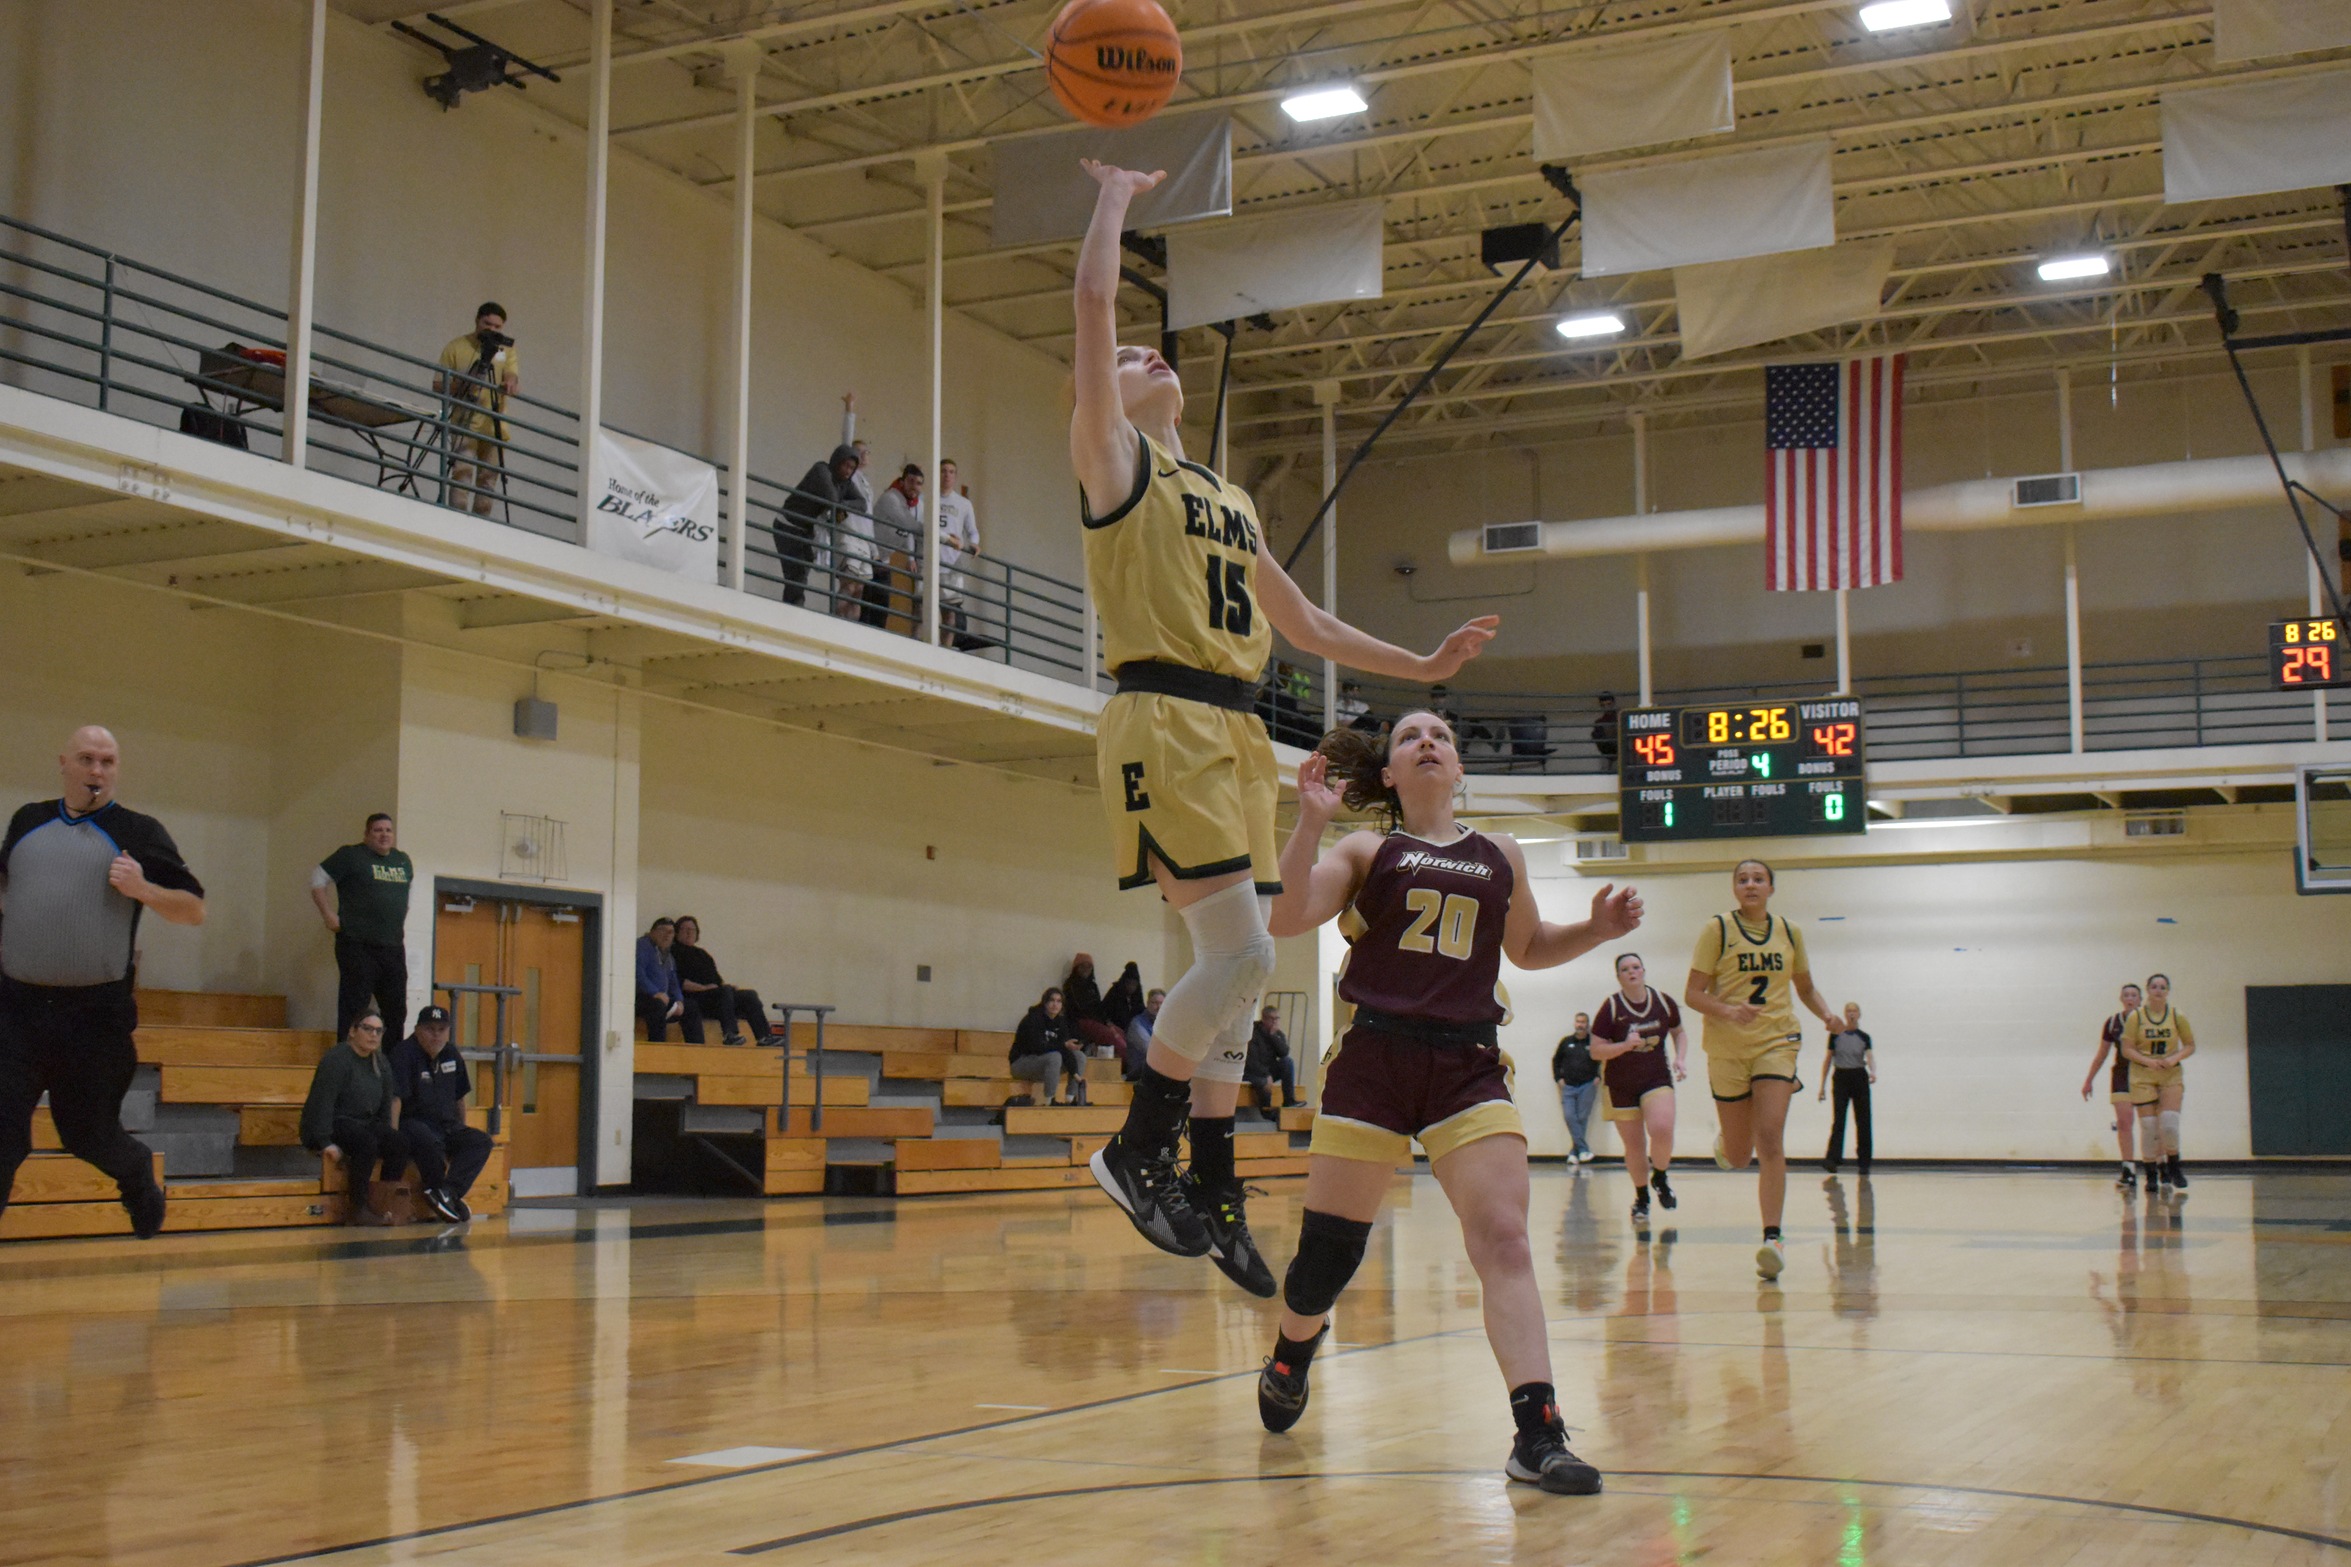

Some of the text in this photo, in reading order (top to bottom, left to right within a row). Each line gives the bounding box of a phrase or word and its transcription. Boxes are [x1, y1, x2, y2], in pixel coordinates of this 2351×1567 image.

[1097, 46, 1176, 73] Wilson
[608, 477, 661, 508] Home of the
[596, 493, 714, 542] BLAERS
[1181, 493, 1257, 556] ELMS
[1205, 553, 1252, 637] 15
[2285, 621, 2337, 643] 8 26
[2281, 645, 2331, 683] 29
[1628, 713, 1671, 729] HOME
[1801, 701, 1860, 719] VISITOR
[1708, 708, 1790, 743] 8:26
[1634, 733, 1675, 765] 45
[1813, 723, 1856, 756] 42
[1646, 769, 1682, 782] BONUS
[1708, 758, 1748, 771] PERIOD
[1751, 752, 1771, 778] 4
[1798, 761, 1835, 774] BONUS
[1121, 761, 1151, 812] E
[1640, 788, 1674, 801] FOULS
[1703, 783, 1786, 798] PLAYER FOULS
[1808, 780, 1843, 794] FOULS
[1664, 801, 1674, 827] 1
[1824, 794, 1844, 821] 0
[372, 864, 405, 876] ELMS
[1397, 851, 1491, 879] Norwich
[1397, 888, 1480, 961] 20
[1737, 952, 1784, 972] ELMS
[1748, 975, 1769, 1005] 2
[2145, 1028, 2172, 1039] ELMS
